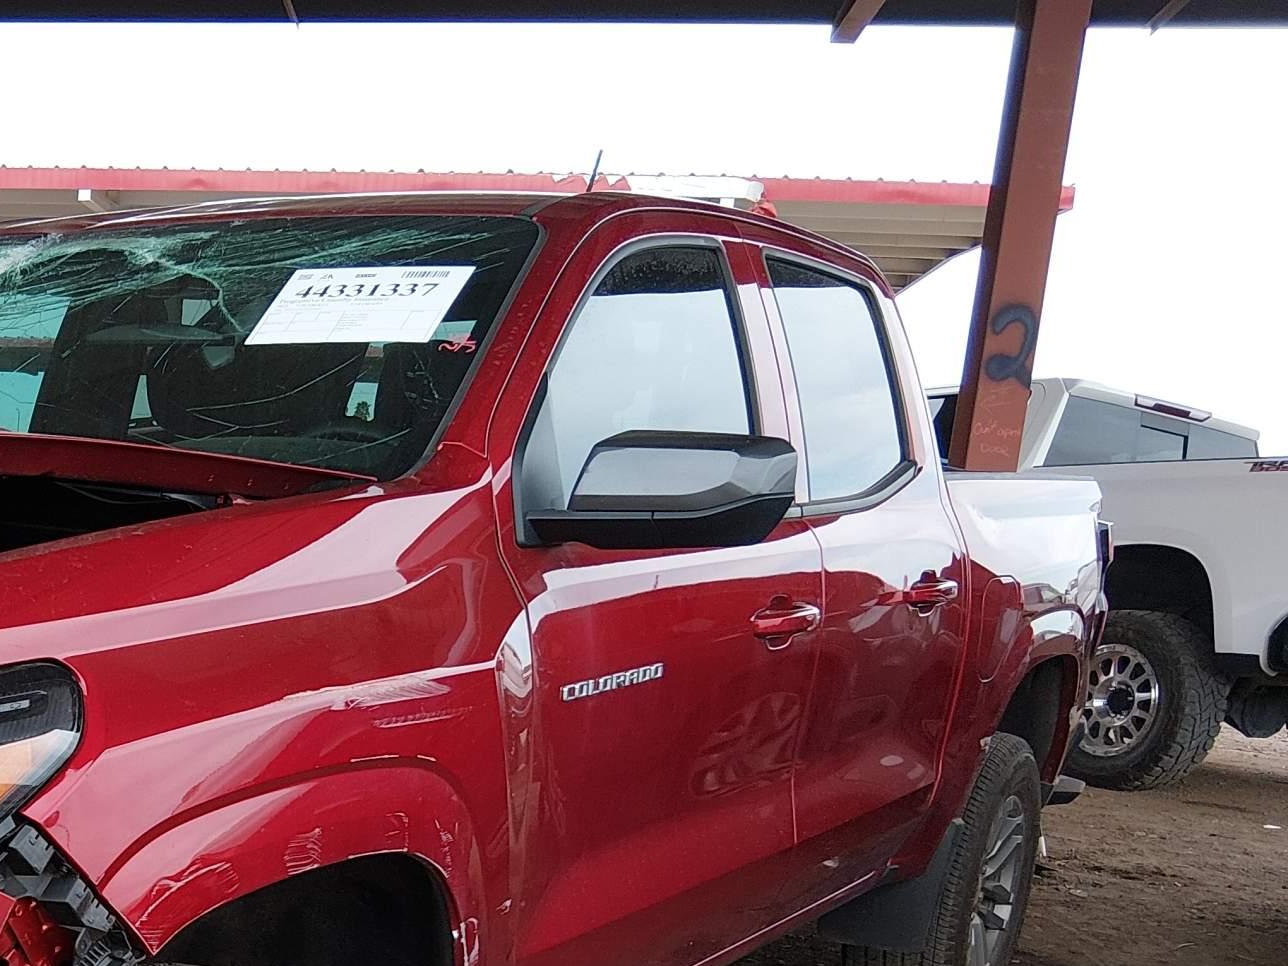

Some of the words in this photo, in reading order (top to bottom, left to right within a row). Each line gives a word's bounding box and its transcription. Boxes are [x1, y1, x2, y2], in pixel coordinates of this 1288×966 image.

[295, 282, 441, 298] 44331337
[985, 303, 1037, 389] 2
[560, 662, 665, 702] COLORADO
